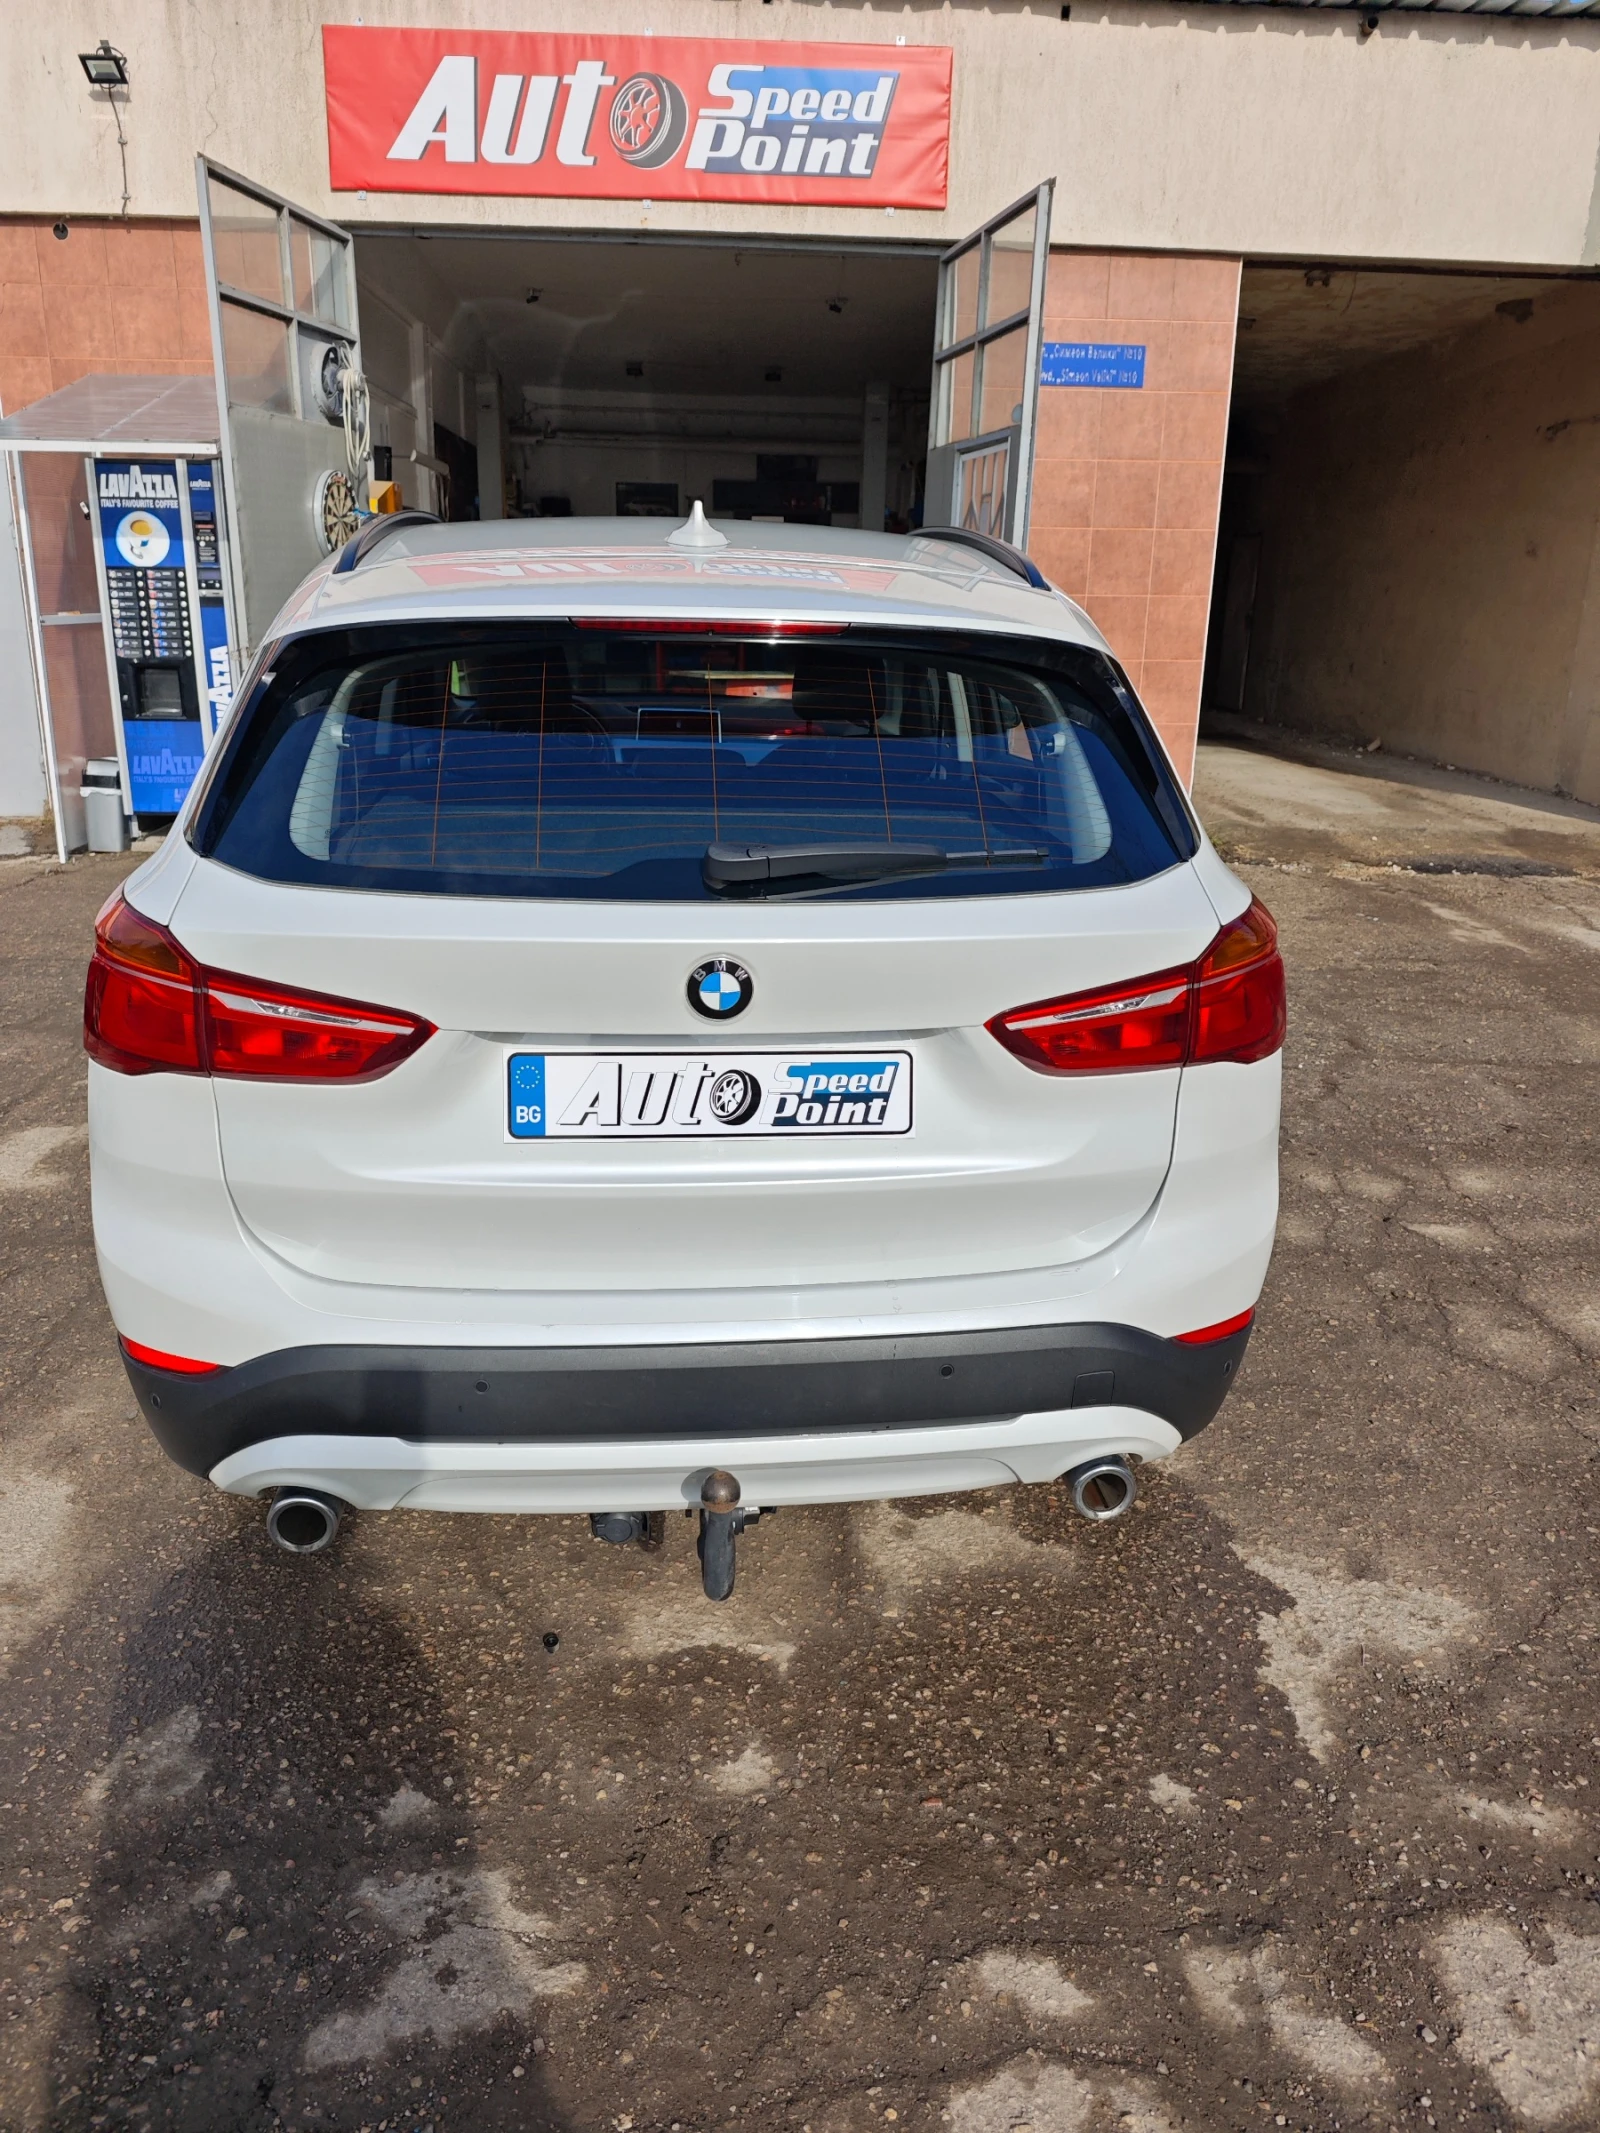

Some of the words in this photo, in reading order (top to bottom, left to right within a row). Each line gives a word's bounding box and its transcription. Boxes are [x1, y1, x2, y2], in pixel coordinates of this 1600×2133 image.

[698, 63, 895, 129] Speed
[684, 118, 879, 175] Point
[100, 465, 178, 498] LAVAZZA
[100, 499, 121, 508] ITALY'S
[122, 499, 154, 508] FAVOURITE
[155, 500, 179, 509] COFFEE
[692, 959, 749, 982] BMW
[768, 1061, 897, 1100] Speed
[516, 1105, 542, 1124] BG
[760, 1094, 888, 1125] Point
